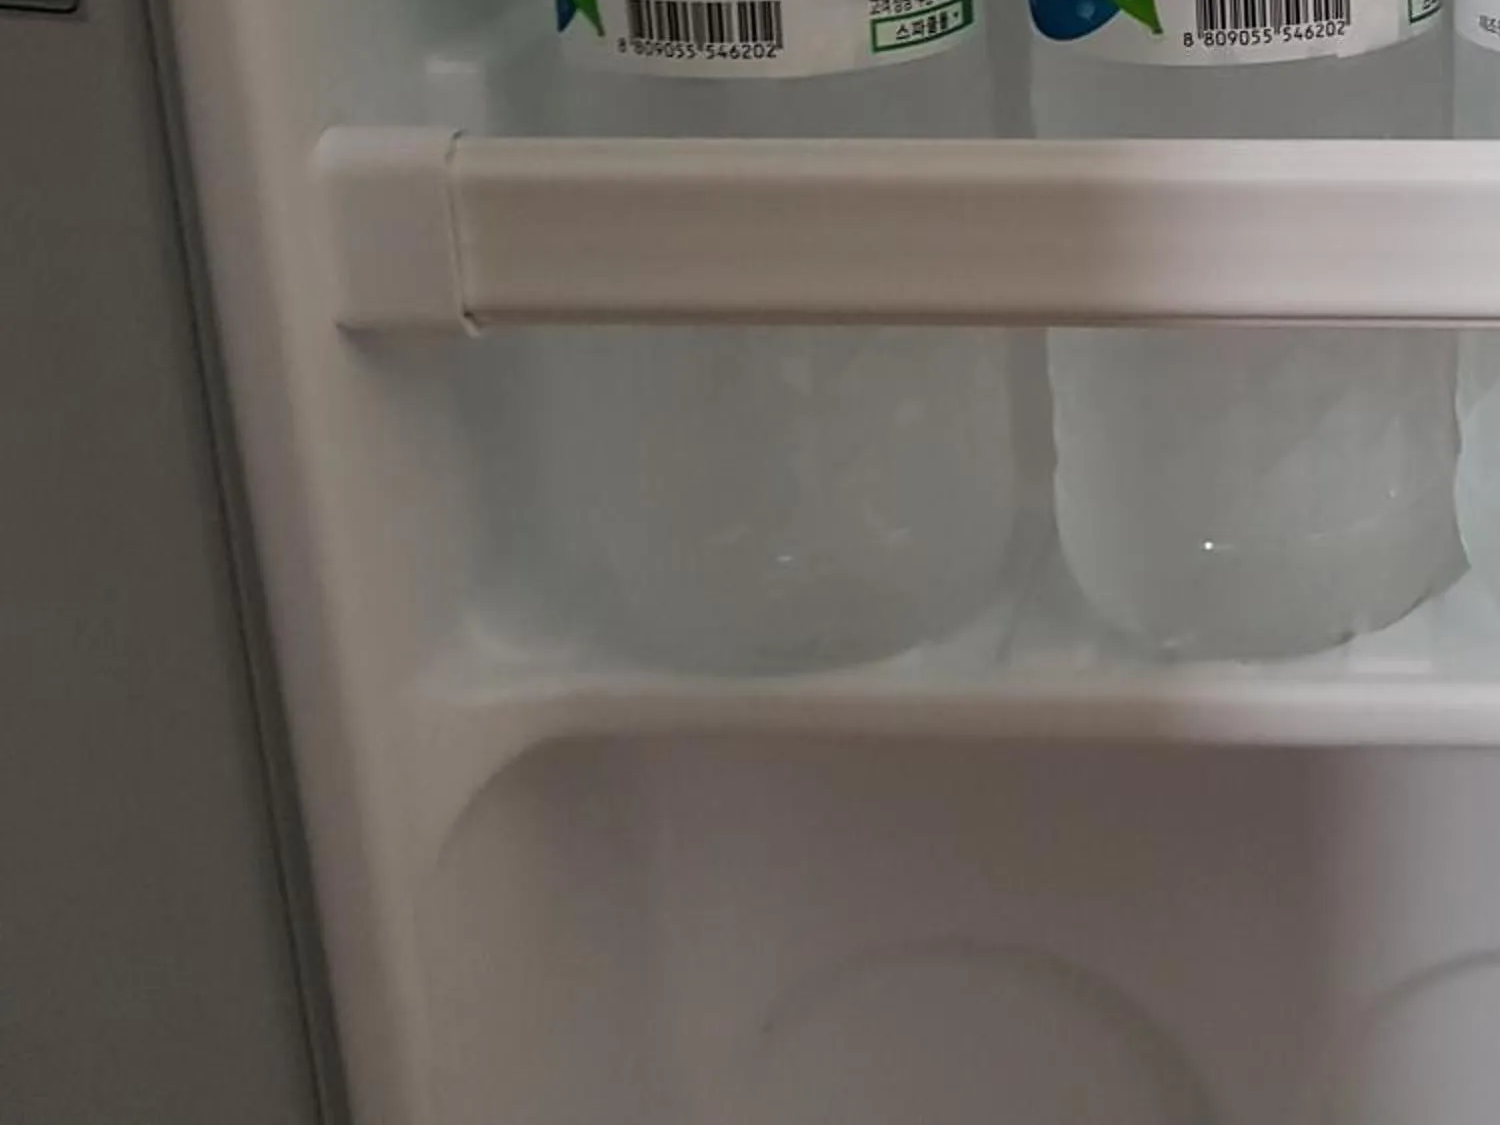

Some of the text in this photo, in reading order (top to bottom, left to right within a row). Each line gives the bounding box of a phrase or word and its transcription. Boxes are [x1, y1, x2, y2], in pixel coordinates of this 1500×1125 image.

[1184, 20, 1346, 47] 8 809055 546202
